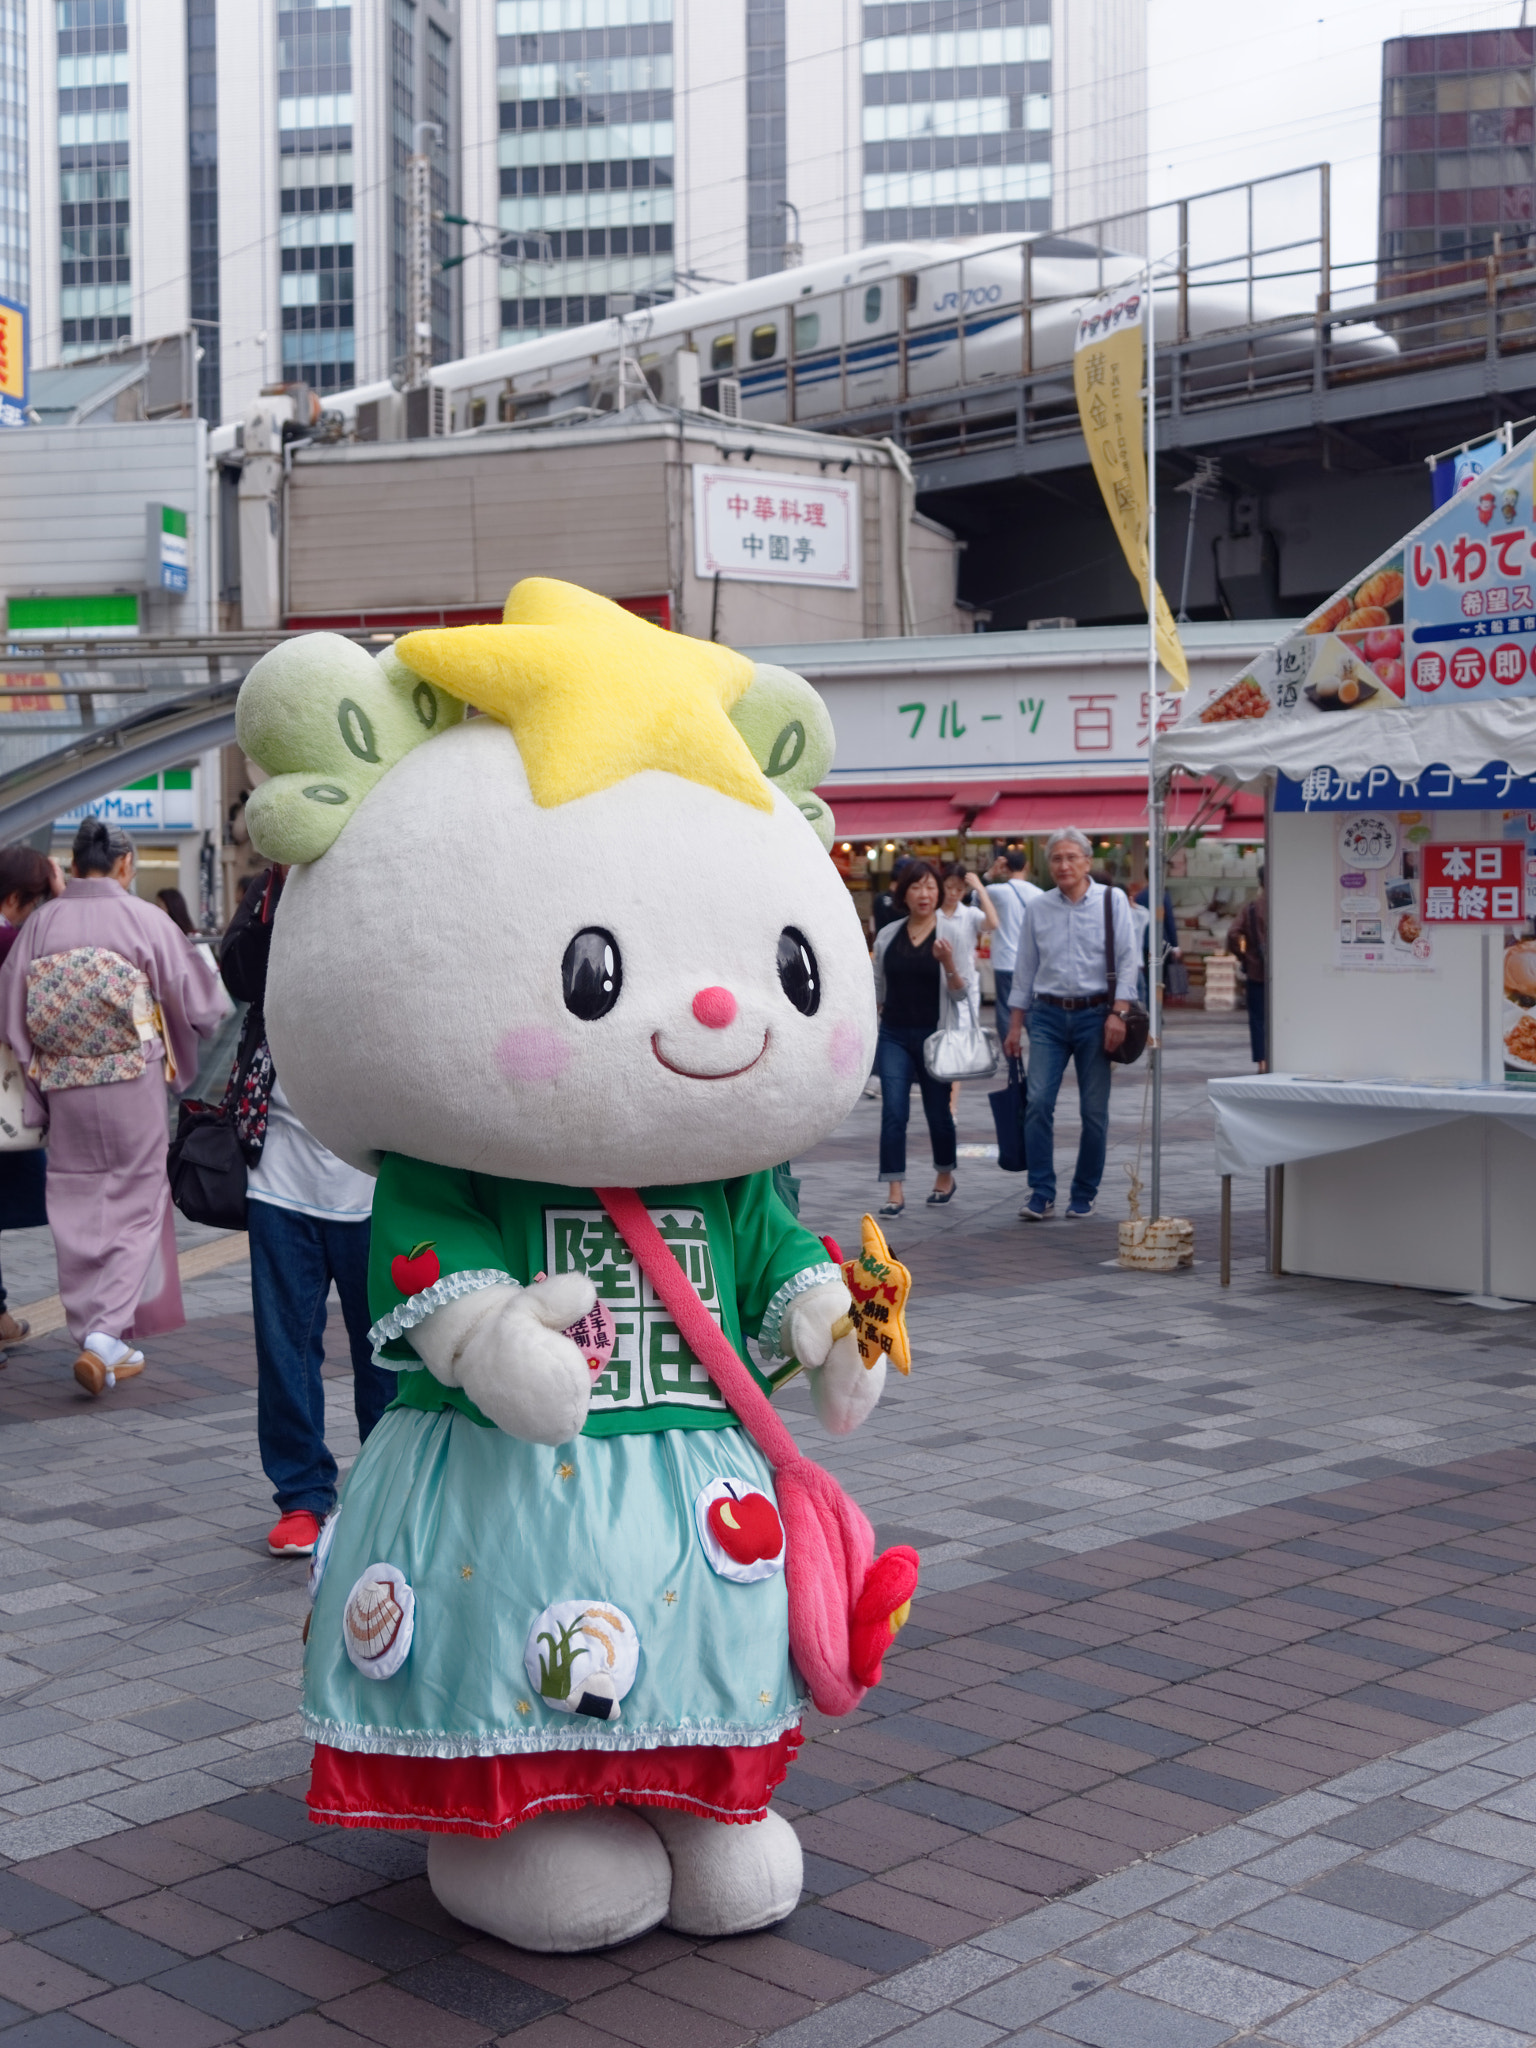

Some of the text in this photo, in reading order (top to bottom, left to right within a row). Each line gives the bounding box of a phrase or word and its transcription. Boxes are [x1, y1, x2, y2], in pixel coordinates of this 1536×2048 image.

[726, 492, 827, 528] 中華料理
[741, 532, 816, 563] 中園亭
[1413, 529, 1536, 588] いわて
[899, 697, 1045, 739] フルーツ
[1441, 847, 1502, 882] 本日
[1425, 885, 1519, 920] 最終日
